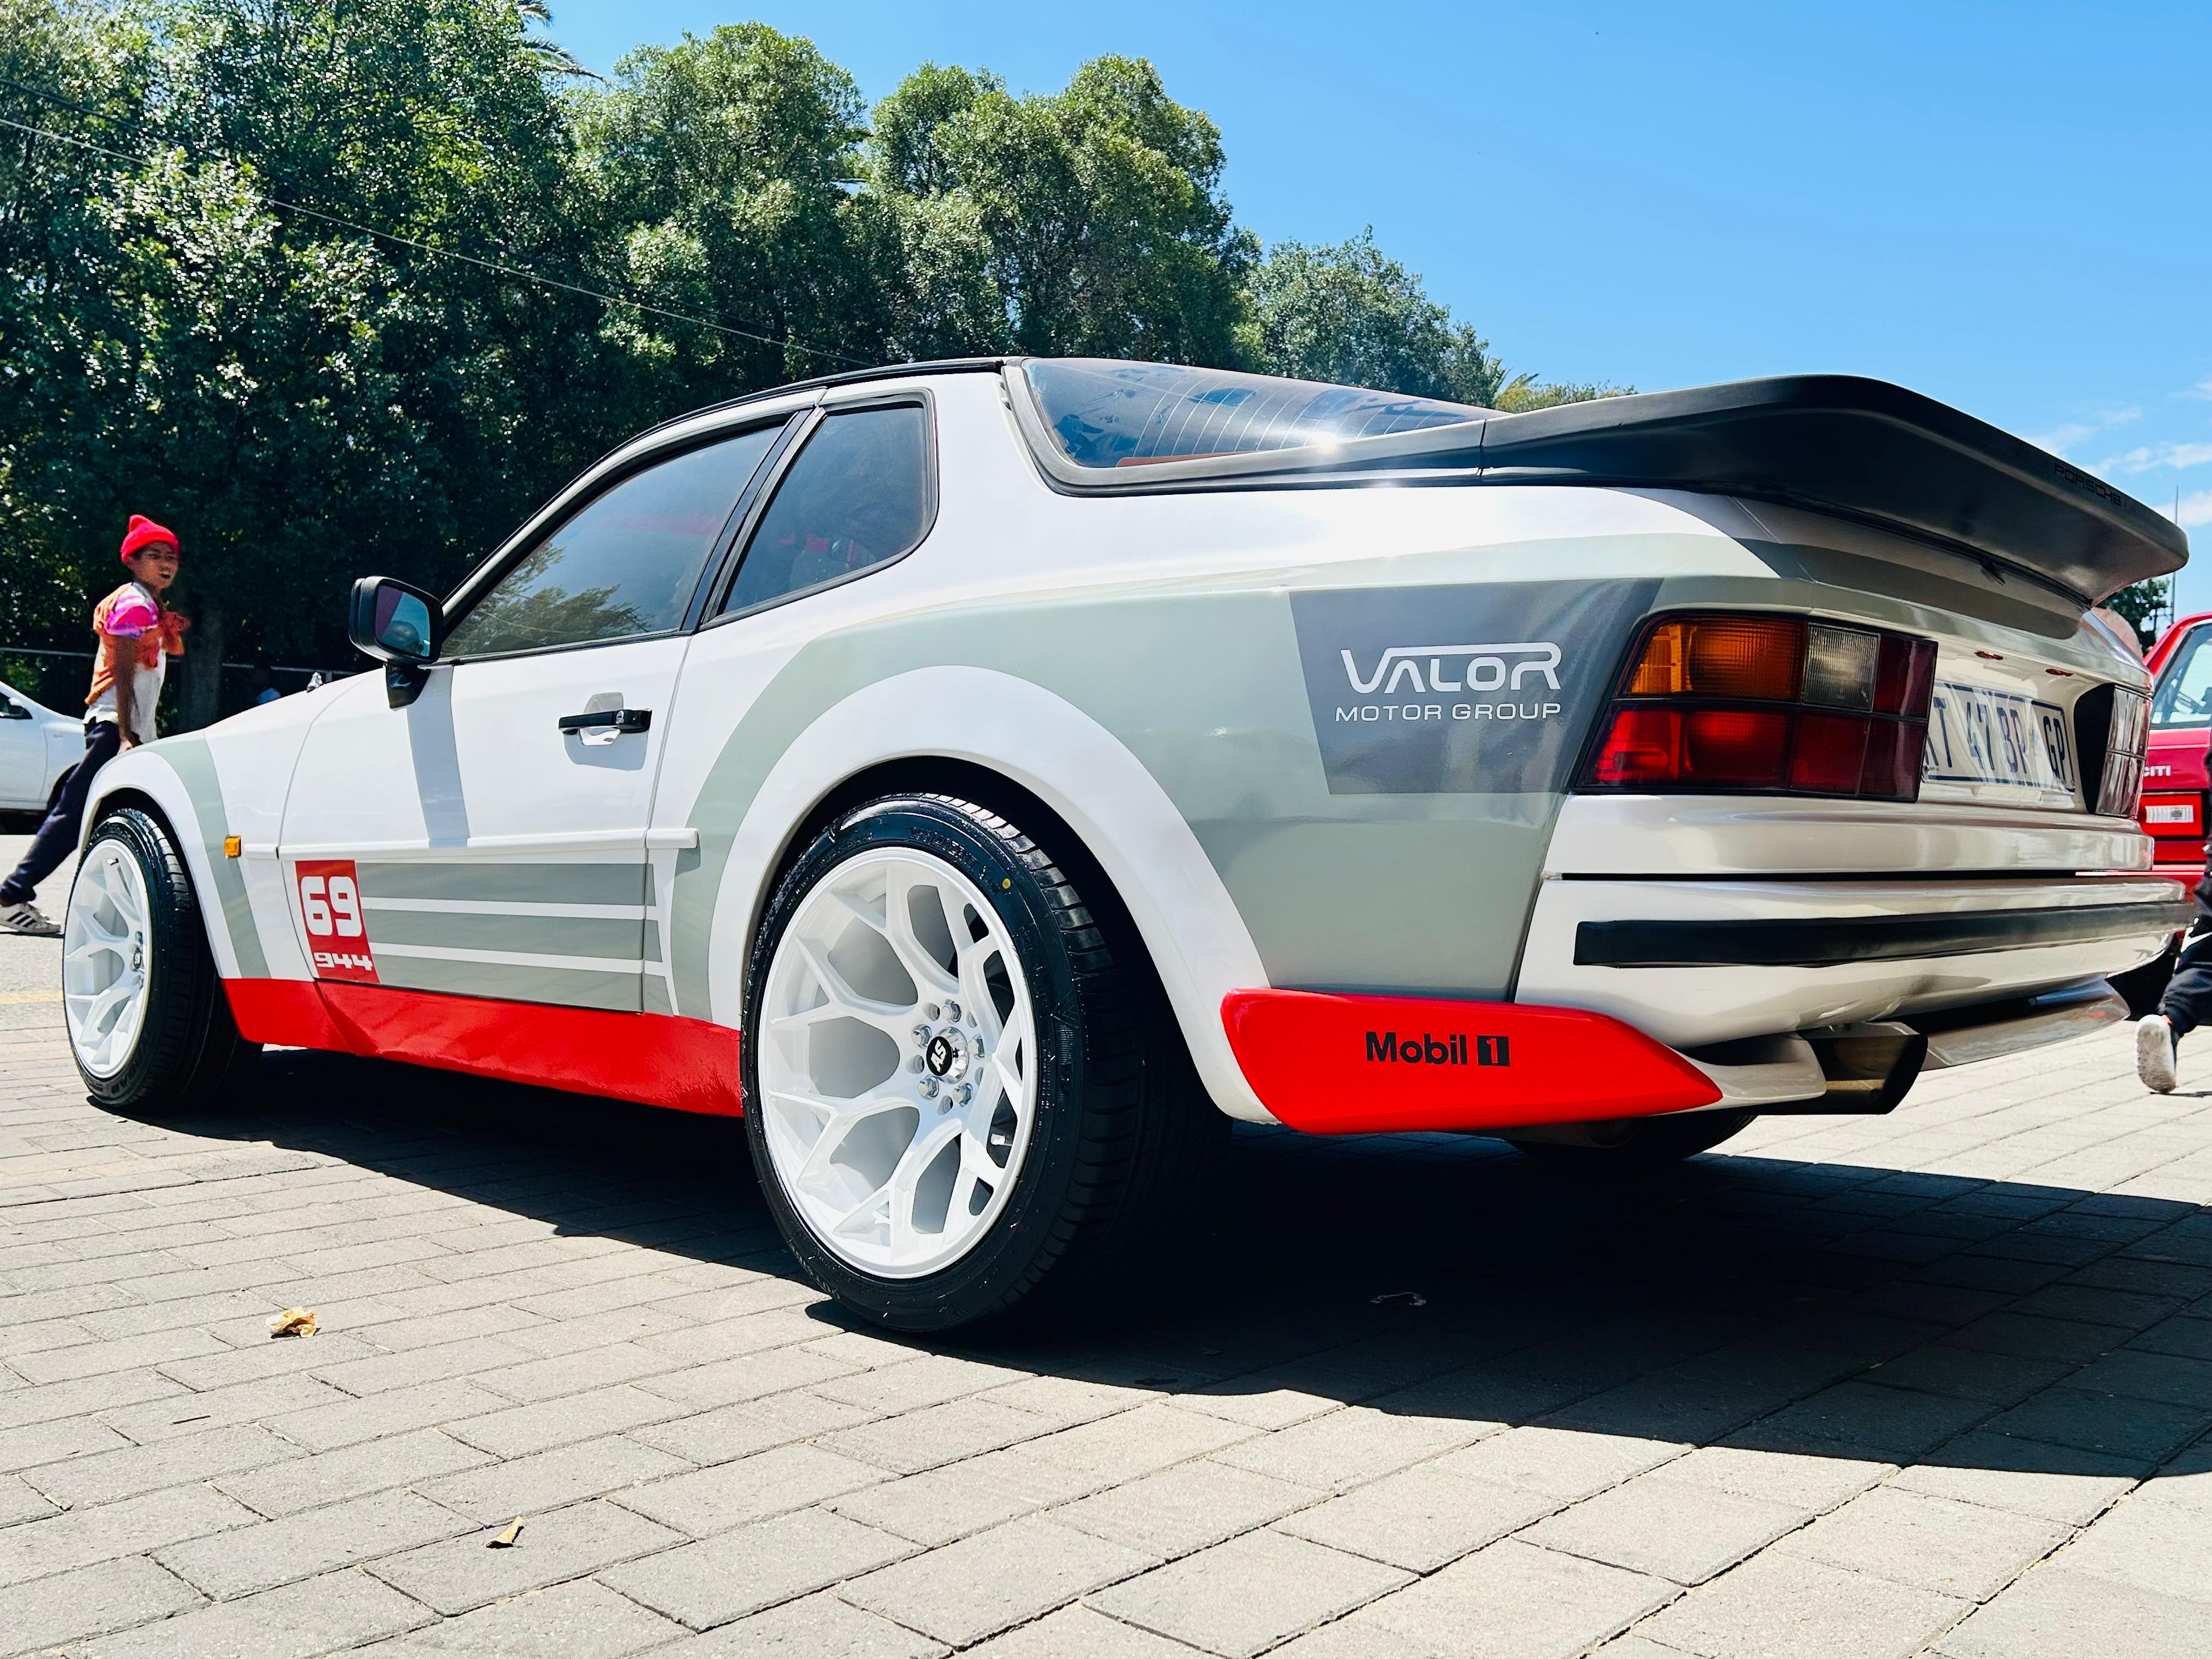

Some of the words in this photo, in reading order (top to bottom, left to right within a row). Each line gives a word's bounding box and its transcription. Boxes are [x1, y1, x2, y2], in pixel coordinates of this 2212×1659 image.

[2053, 462, 2121, 507] PORSCHE
[1340, 641, 1562, 694] VALOR
[1335, 704, 1442, 722] MOTOR
[1451, 702, 1561, 720] GROUP
[2042, 715, 2066, 782] GP
[300, 876, 362, 937] 69
[313, 952, 373, 971] 944
[1365, 1031, 1468, 1065] Mobil
